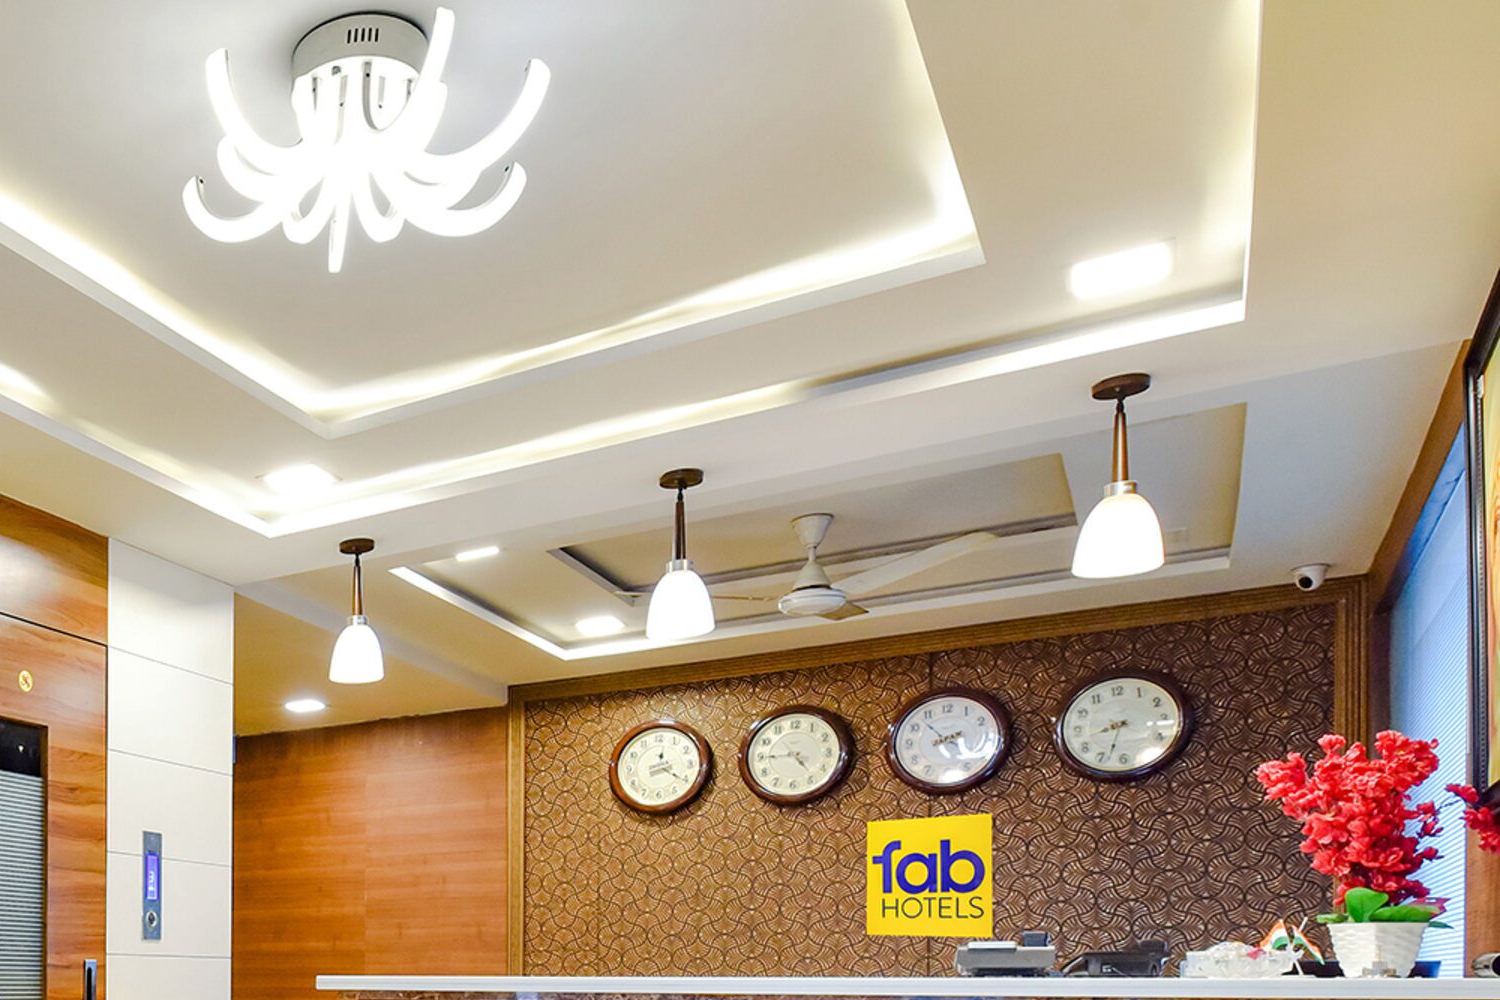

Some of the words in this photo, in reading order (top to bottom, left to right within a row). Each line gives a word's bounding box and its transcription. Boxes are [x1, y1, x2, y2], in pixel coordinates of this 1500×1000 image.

[1111, 686, 1124, 697] 12
[1092, 694, 1101, 704] 11
[1153, 697, 1162, 707] 2
[942, 704, 953, 713] 12
[924, 710, 933, 719] 11
[790, 720, 801, 729] 12
[977, 716, 985, 726] 2
[774, 725, 782, 734] 11
[654, 734, 664, 743] 12
[821, 733, 829, 742] 2
[1119, 753, 1128, 764] 6
[872, 839, 985, 895] fab
[882, 896, 985, 919] HOTELS
